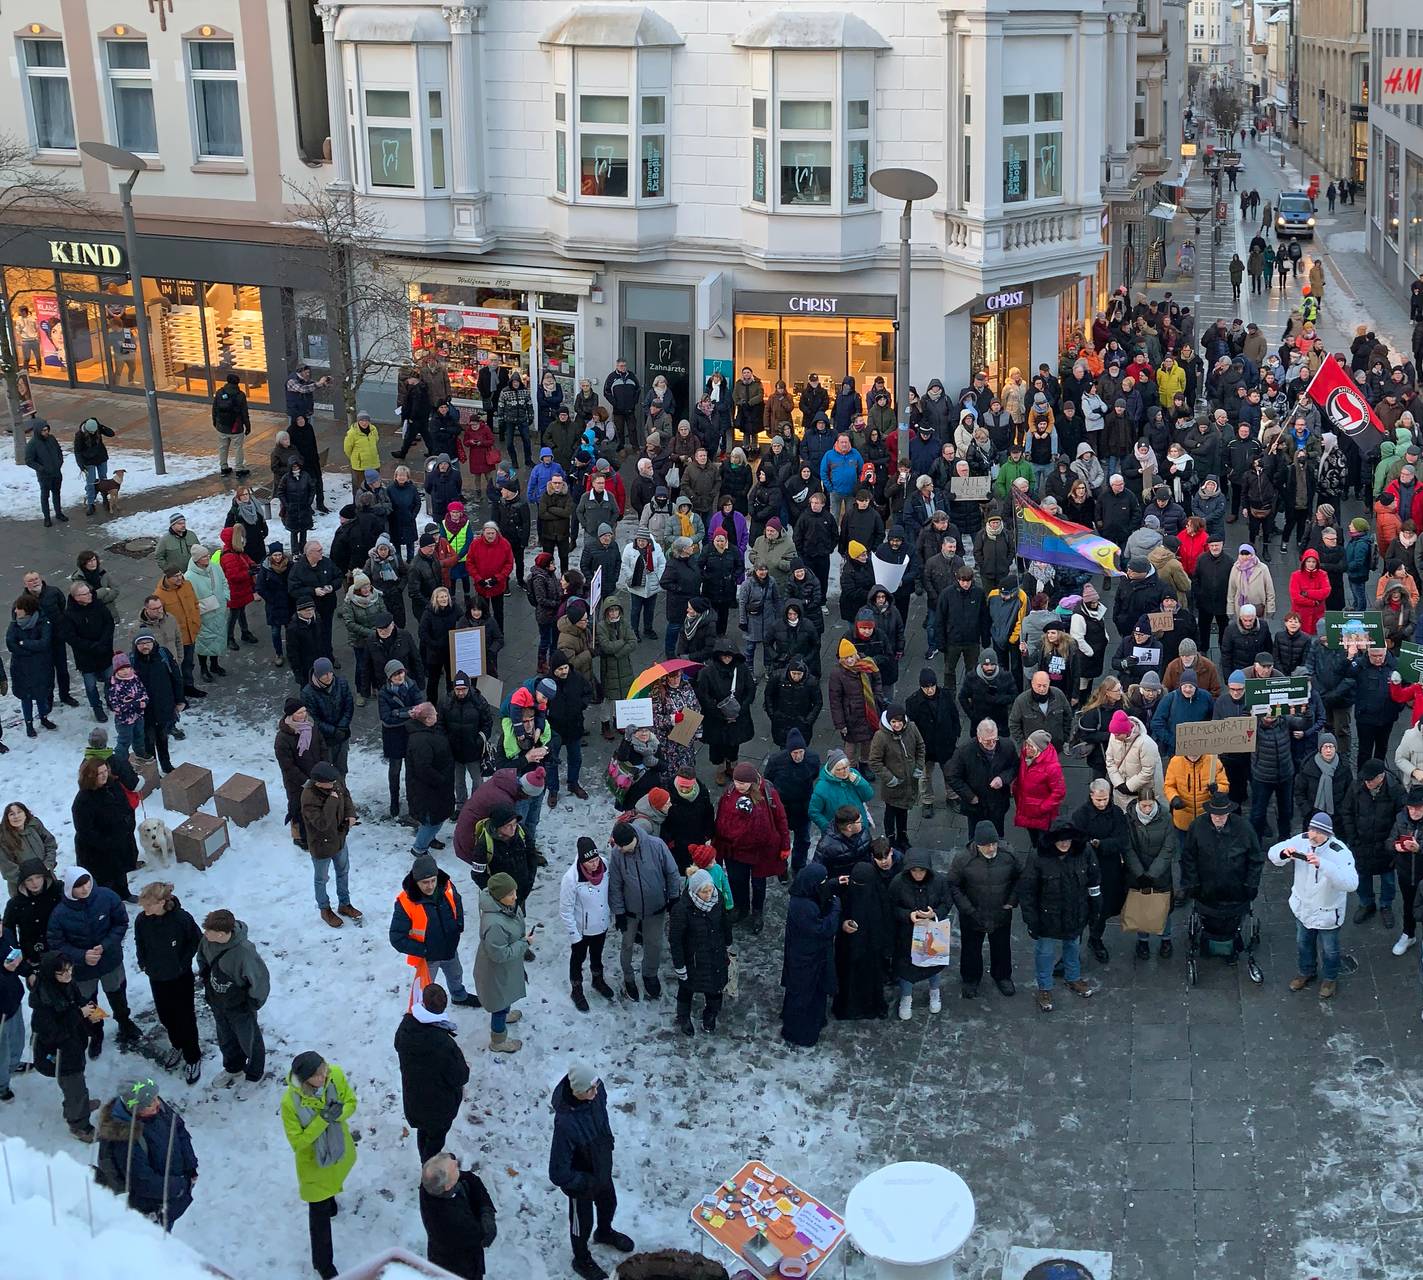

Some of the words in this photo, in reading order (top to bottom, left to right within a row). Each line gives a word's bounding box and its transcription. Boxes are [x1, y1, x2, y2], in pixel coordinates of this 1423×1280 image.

[1384, 67, 1422, 95] H&M
[48, 240, 121, 268] KIND
[789, 297, 837, 312] CHRIST
[985, 290, 1024, 310] CHRIST
[649, 363, 686, 374] Zahnärzte
